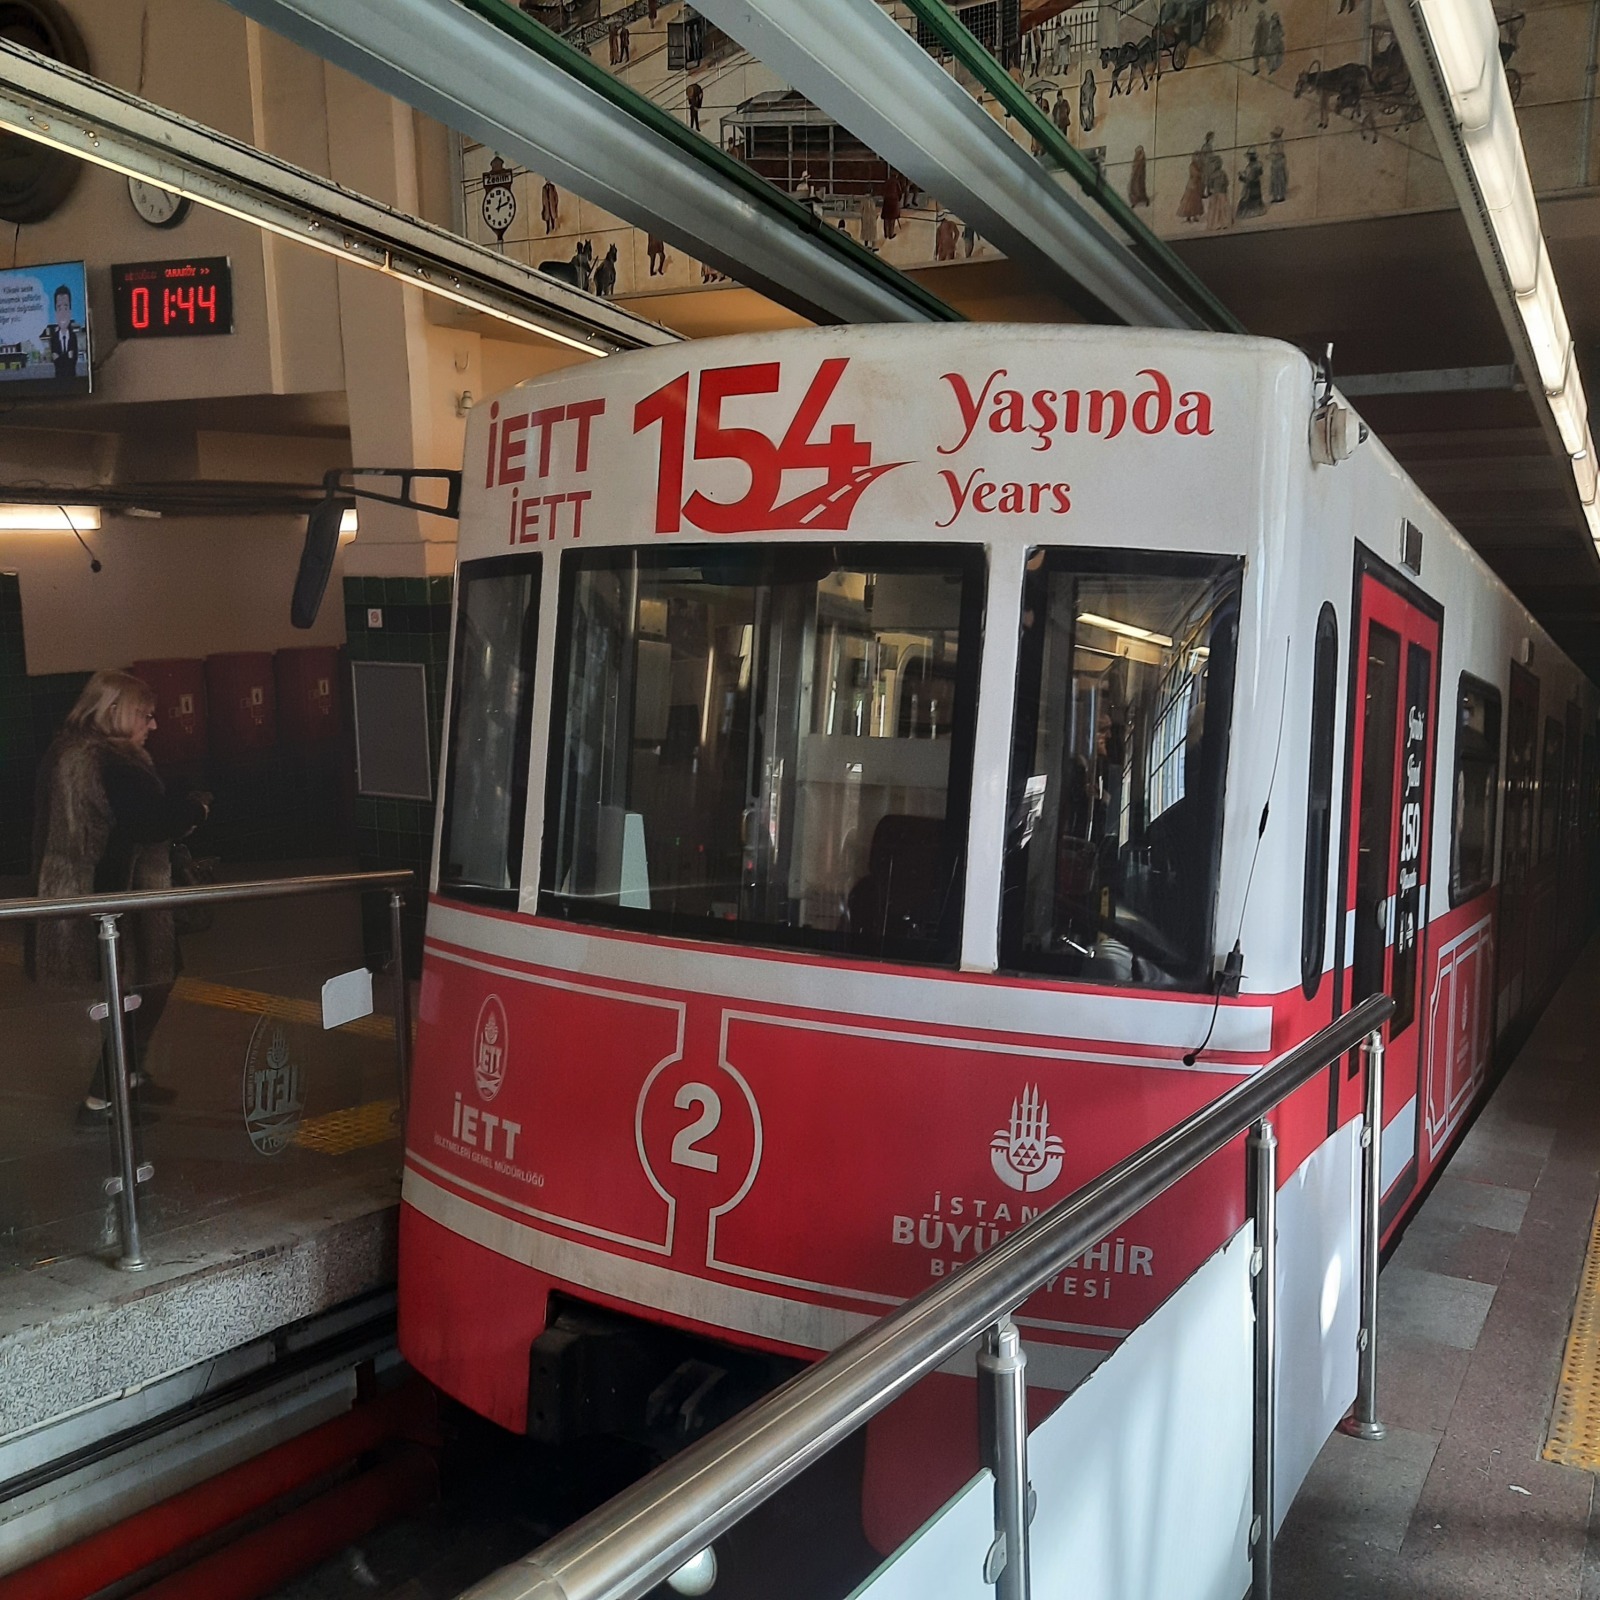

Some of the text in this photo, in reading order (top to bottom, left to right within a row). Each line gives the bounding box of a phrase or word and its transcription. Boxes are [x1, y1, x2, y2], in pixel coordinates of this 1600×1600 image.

[486, 357, 1215, 534] İETT 154 Yaşında
[509, 467, 1072, 545] İETT Years
[1400, 802, 1421, 862] 150
[451, 1091, 522, 1160] İETT
[670, 1082, 722, 1174] 2
[471, 1151, 494, 1168] GENEL
[494, 1160, 545, 1188] MÜDÜRLÜĞÜ
[933, 1190, 1040, 1224] İSTAN
